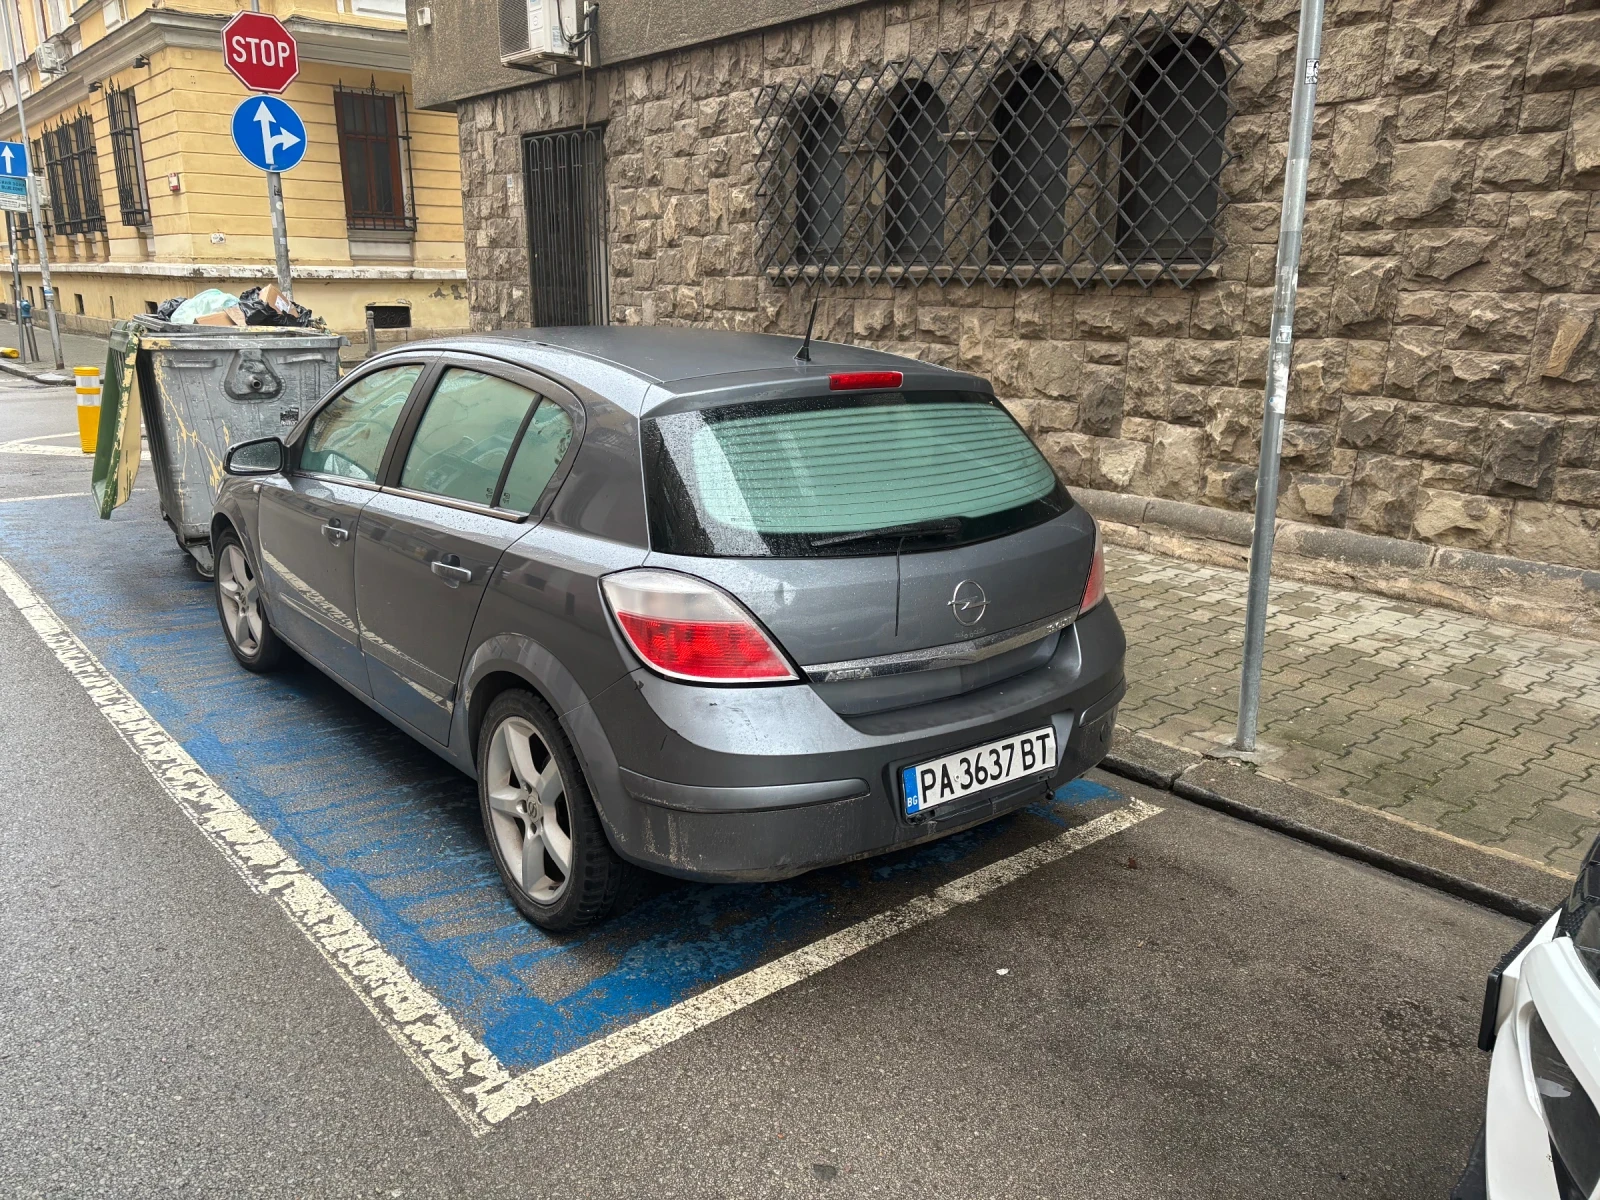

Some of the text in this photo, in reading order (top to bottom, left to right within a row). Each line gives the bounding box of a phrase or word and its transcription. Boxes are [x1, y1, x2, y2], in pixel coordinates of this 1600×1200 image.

[231, 35, 290, 68] STOP
[824, 667, 873, 683] ASTRA
[920, 733, 1051, 804] PA 3637 BT
[907, 795, 918, 807] BG
